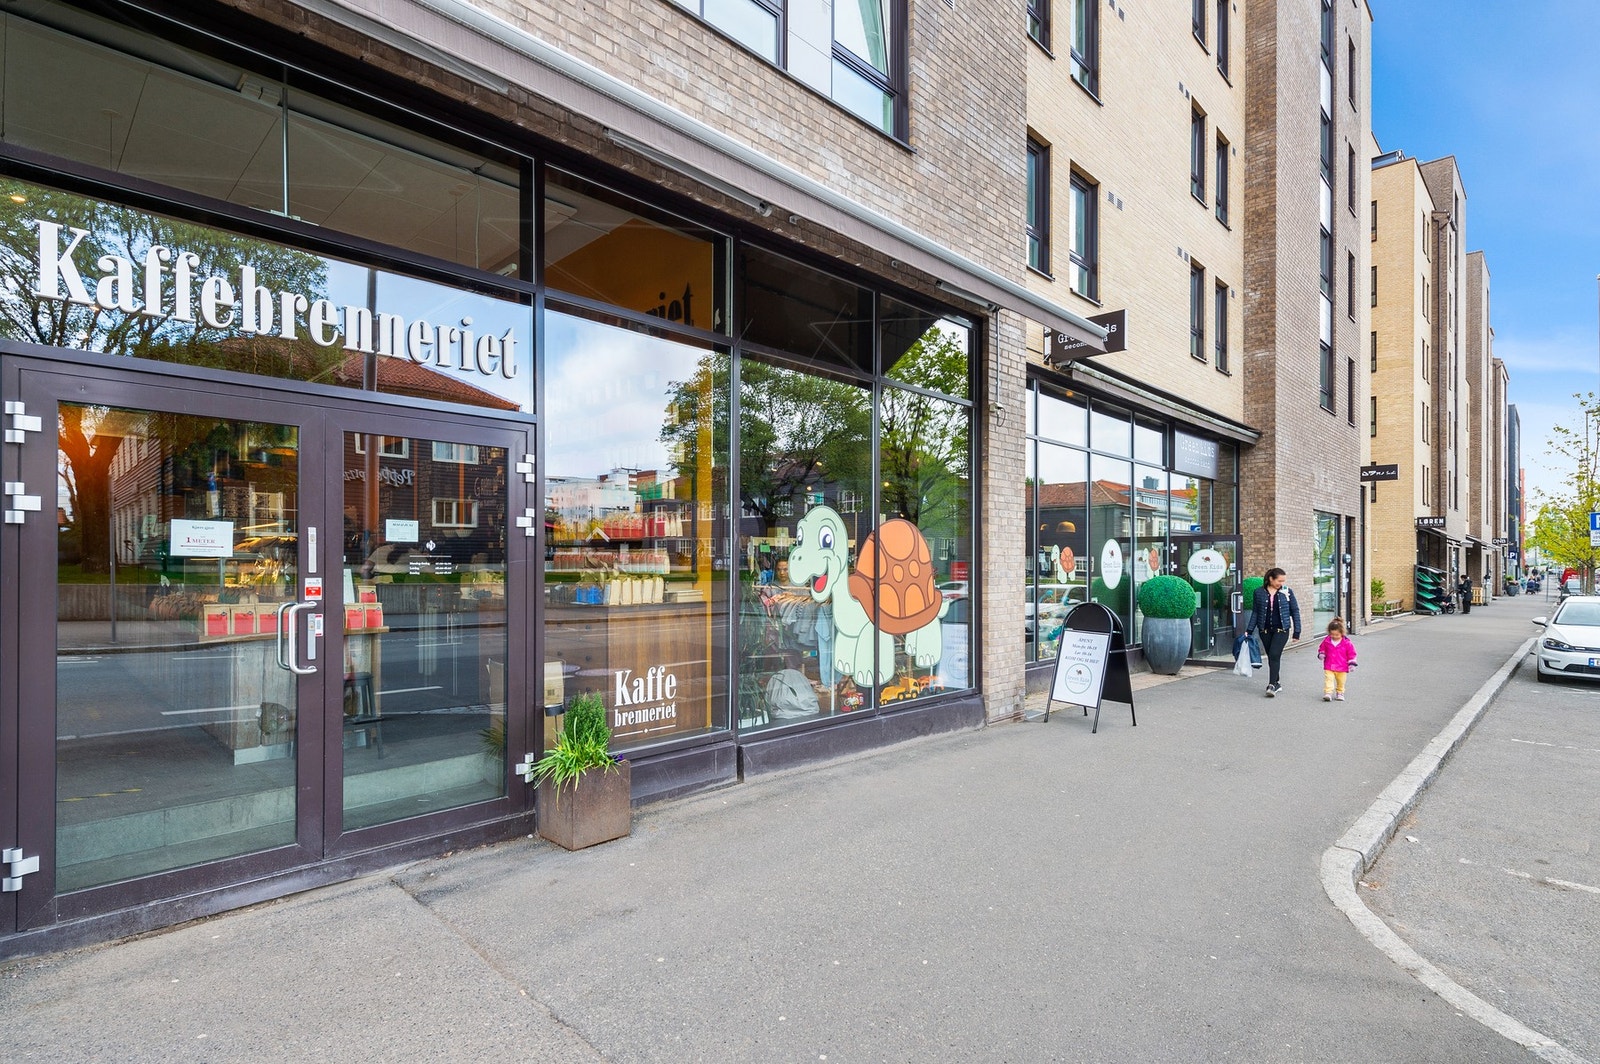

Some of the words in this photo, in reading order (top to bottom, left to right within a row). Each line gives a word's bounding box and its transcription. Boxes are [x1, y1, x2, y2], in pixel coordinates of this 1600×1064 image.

[34, 218, 519, 380] Kaffebrenneriet
[1509, 551, 1515, 559] P
[614, 665, 677, 707] Kaffe
[614, 700, 676, 728] brenneriet
